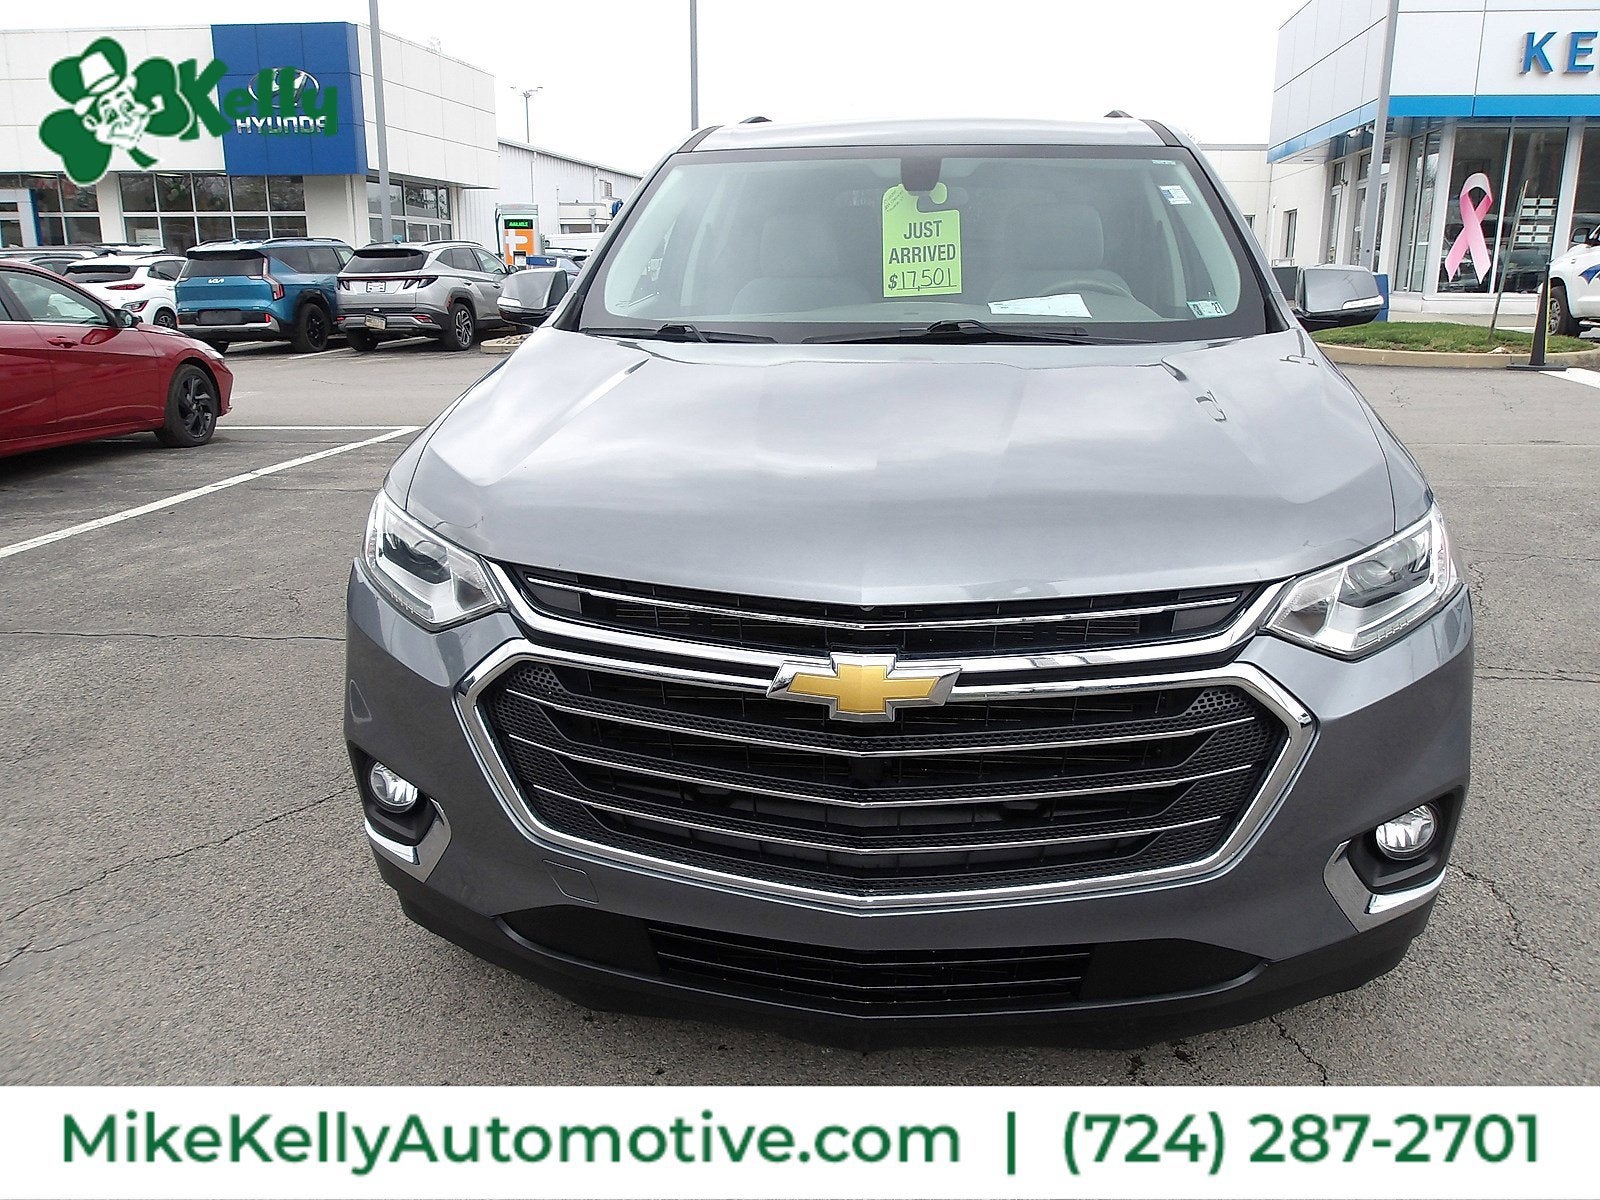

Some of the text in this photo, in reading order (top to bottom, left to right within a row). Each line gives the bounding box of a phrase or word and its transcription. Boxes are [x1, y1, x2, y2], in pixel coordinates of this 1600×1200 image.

[236, 115, 328, 134] HYUNDA
[904, 220, 942, 239] JUST
[889, 243, 956, 264] ARRIVED
